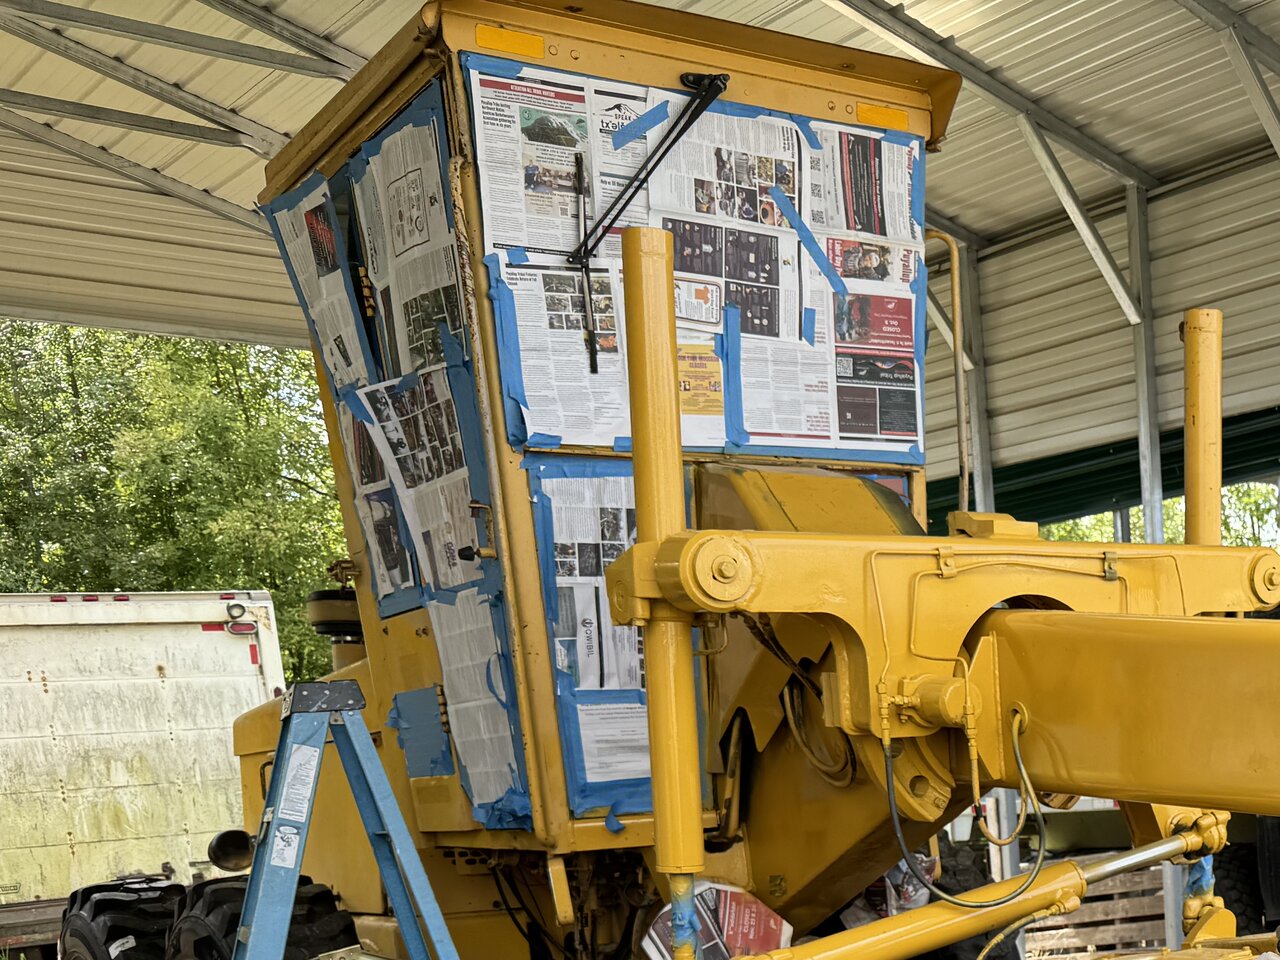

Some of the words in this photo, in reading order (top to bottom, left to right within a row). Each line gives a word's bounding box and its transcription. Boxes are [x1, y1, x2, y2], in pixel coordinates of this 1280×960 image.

[614, 113, 631, 121] SPEAK
[834, 240, 843, 256] Labor
[900, 249, 913, 284] Puyallup
